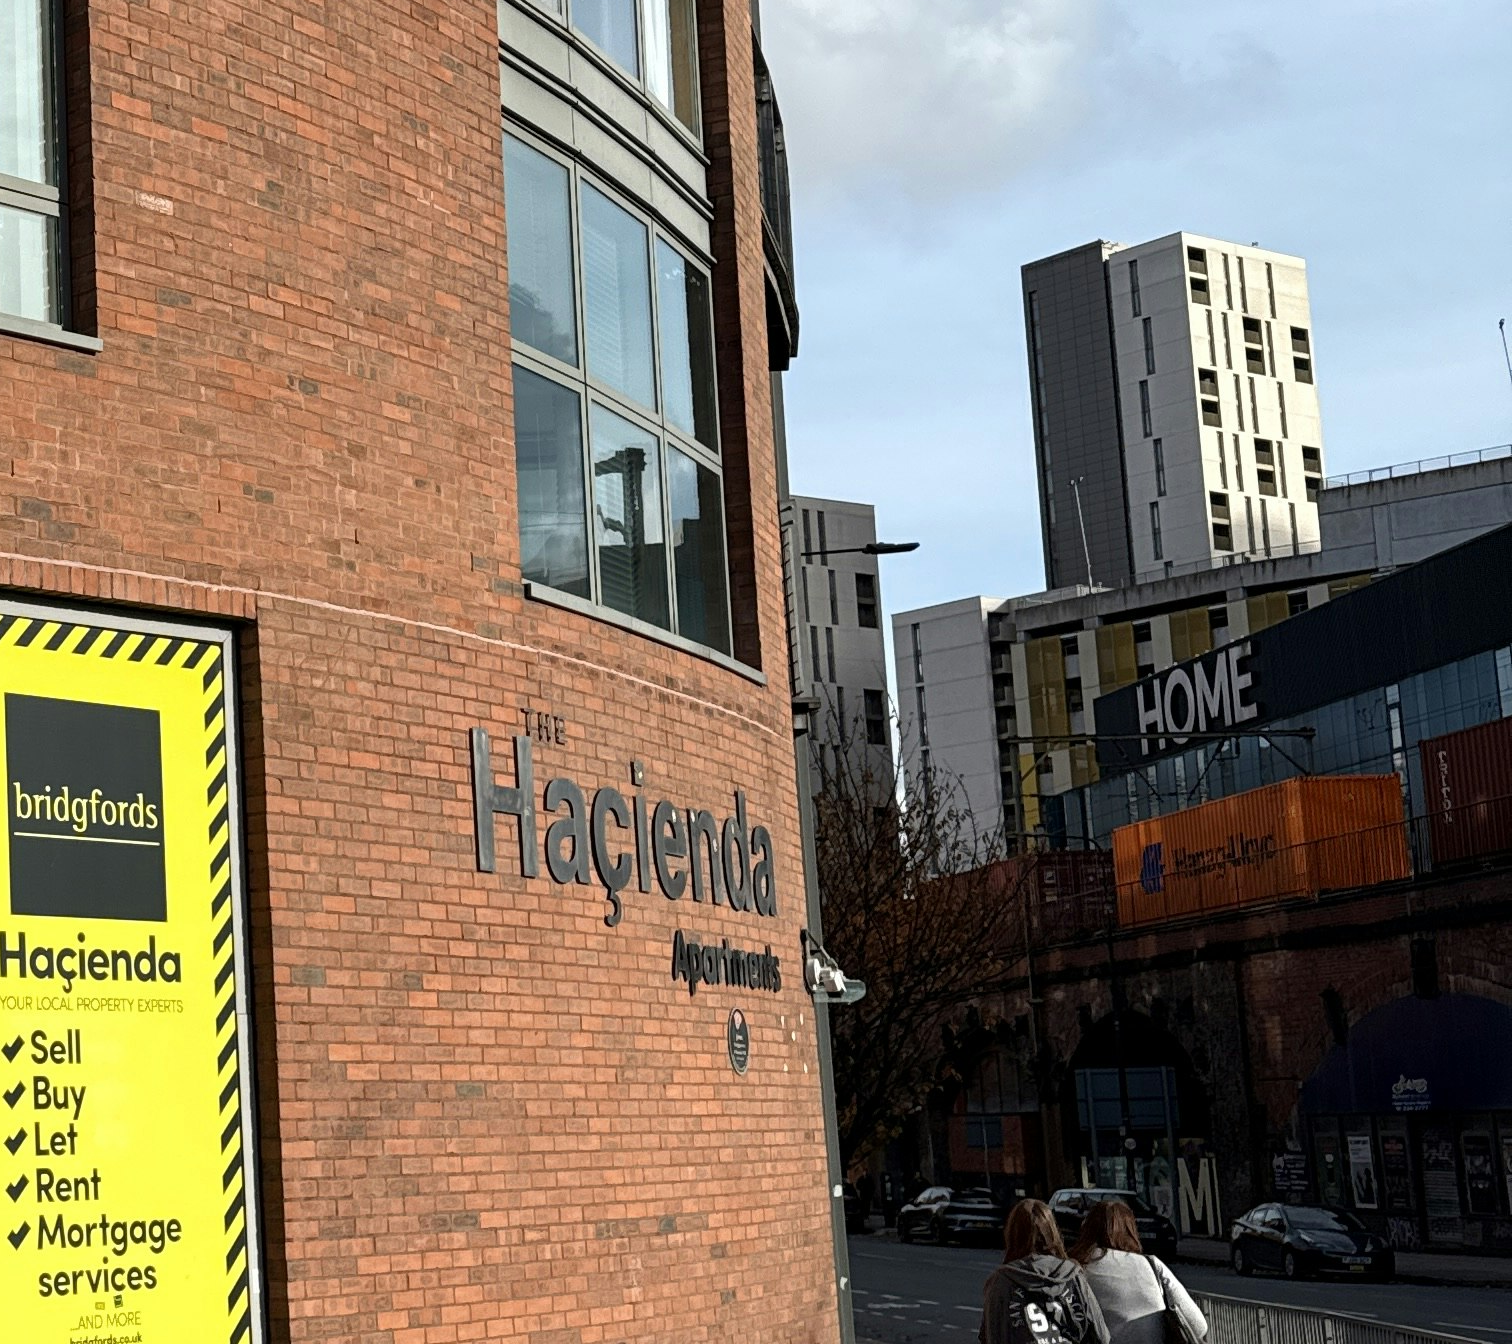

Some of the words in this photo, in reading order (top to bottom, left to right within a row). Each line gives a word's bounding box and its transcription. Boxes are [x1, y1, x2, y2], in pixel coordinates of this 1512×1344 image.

[1136, 641, 1258, 755] HOME
[520, 707, 568, 746] THE
[12, 781, 159, 832] bridgfords
[469, 726, 777, 927] Haçienda
[0, 931, 182, 992] Haçienda
[672, 929, 782, 996] Apartments
[0, 995, 33, 1011] YOUR
[36, 996, 73, 1011] LOCAL
[77, 997, 135, 1012] PROPERTY
[138, 999, 184, 1014] EXPERTS
[30, 1029, 82, 1065] Sell
[33, 1075, 86, 1120] Buy
[34, 1121, 78, 1156] Let
[36, 1168, 102, 1203] Rent
[37, 1213, 182, 1256] Mortgage
[38, 1257, 157, 1297] services
[107, 1311, 141, 1329] MORE
